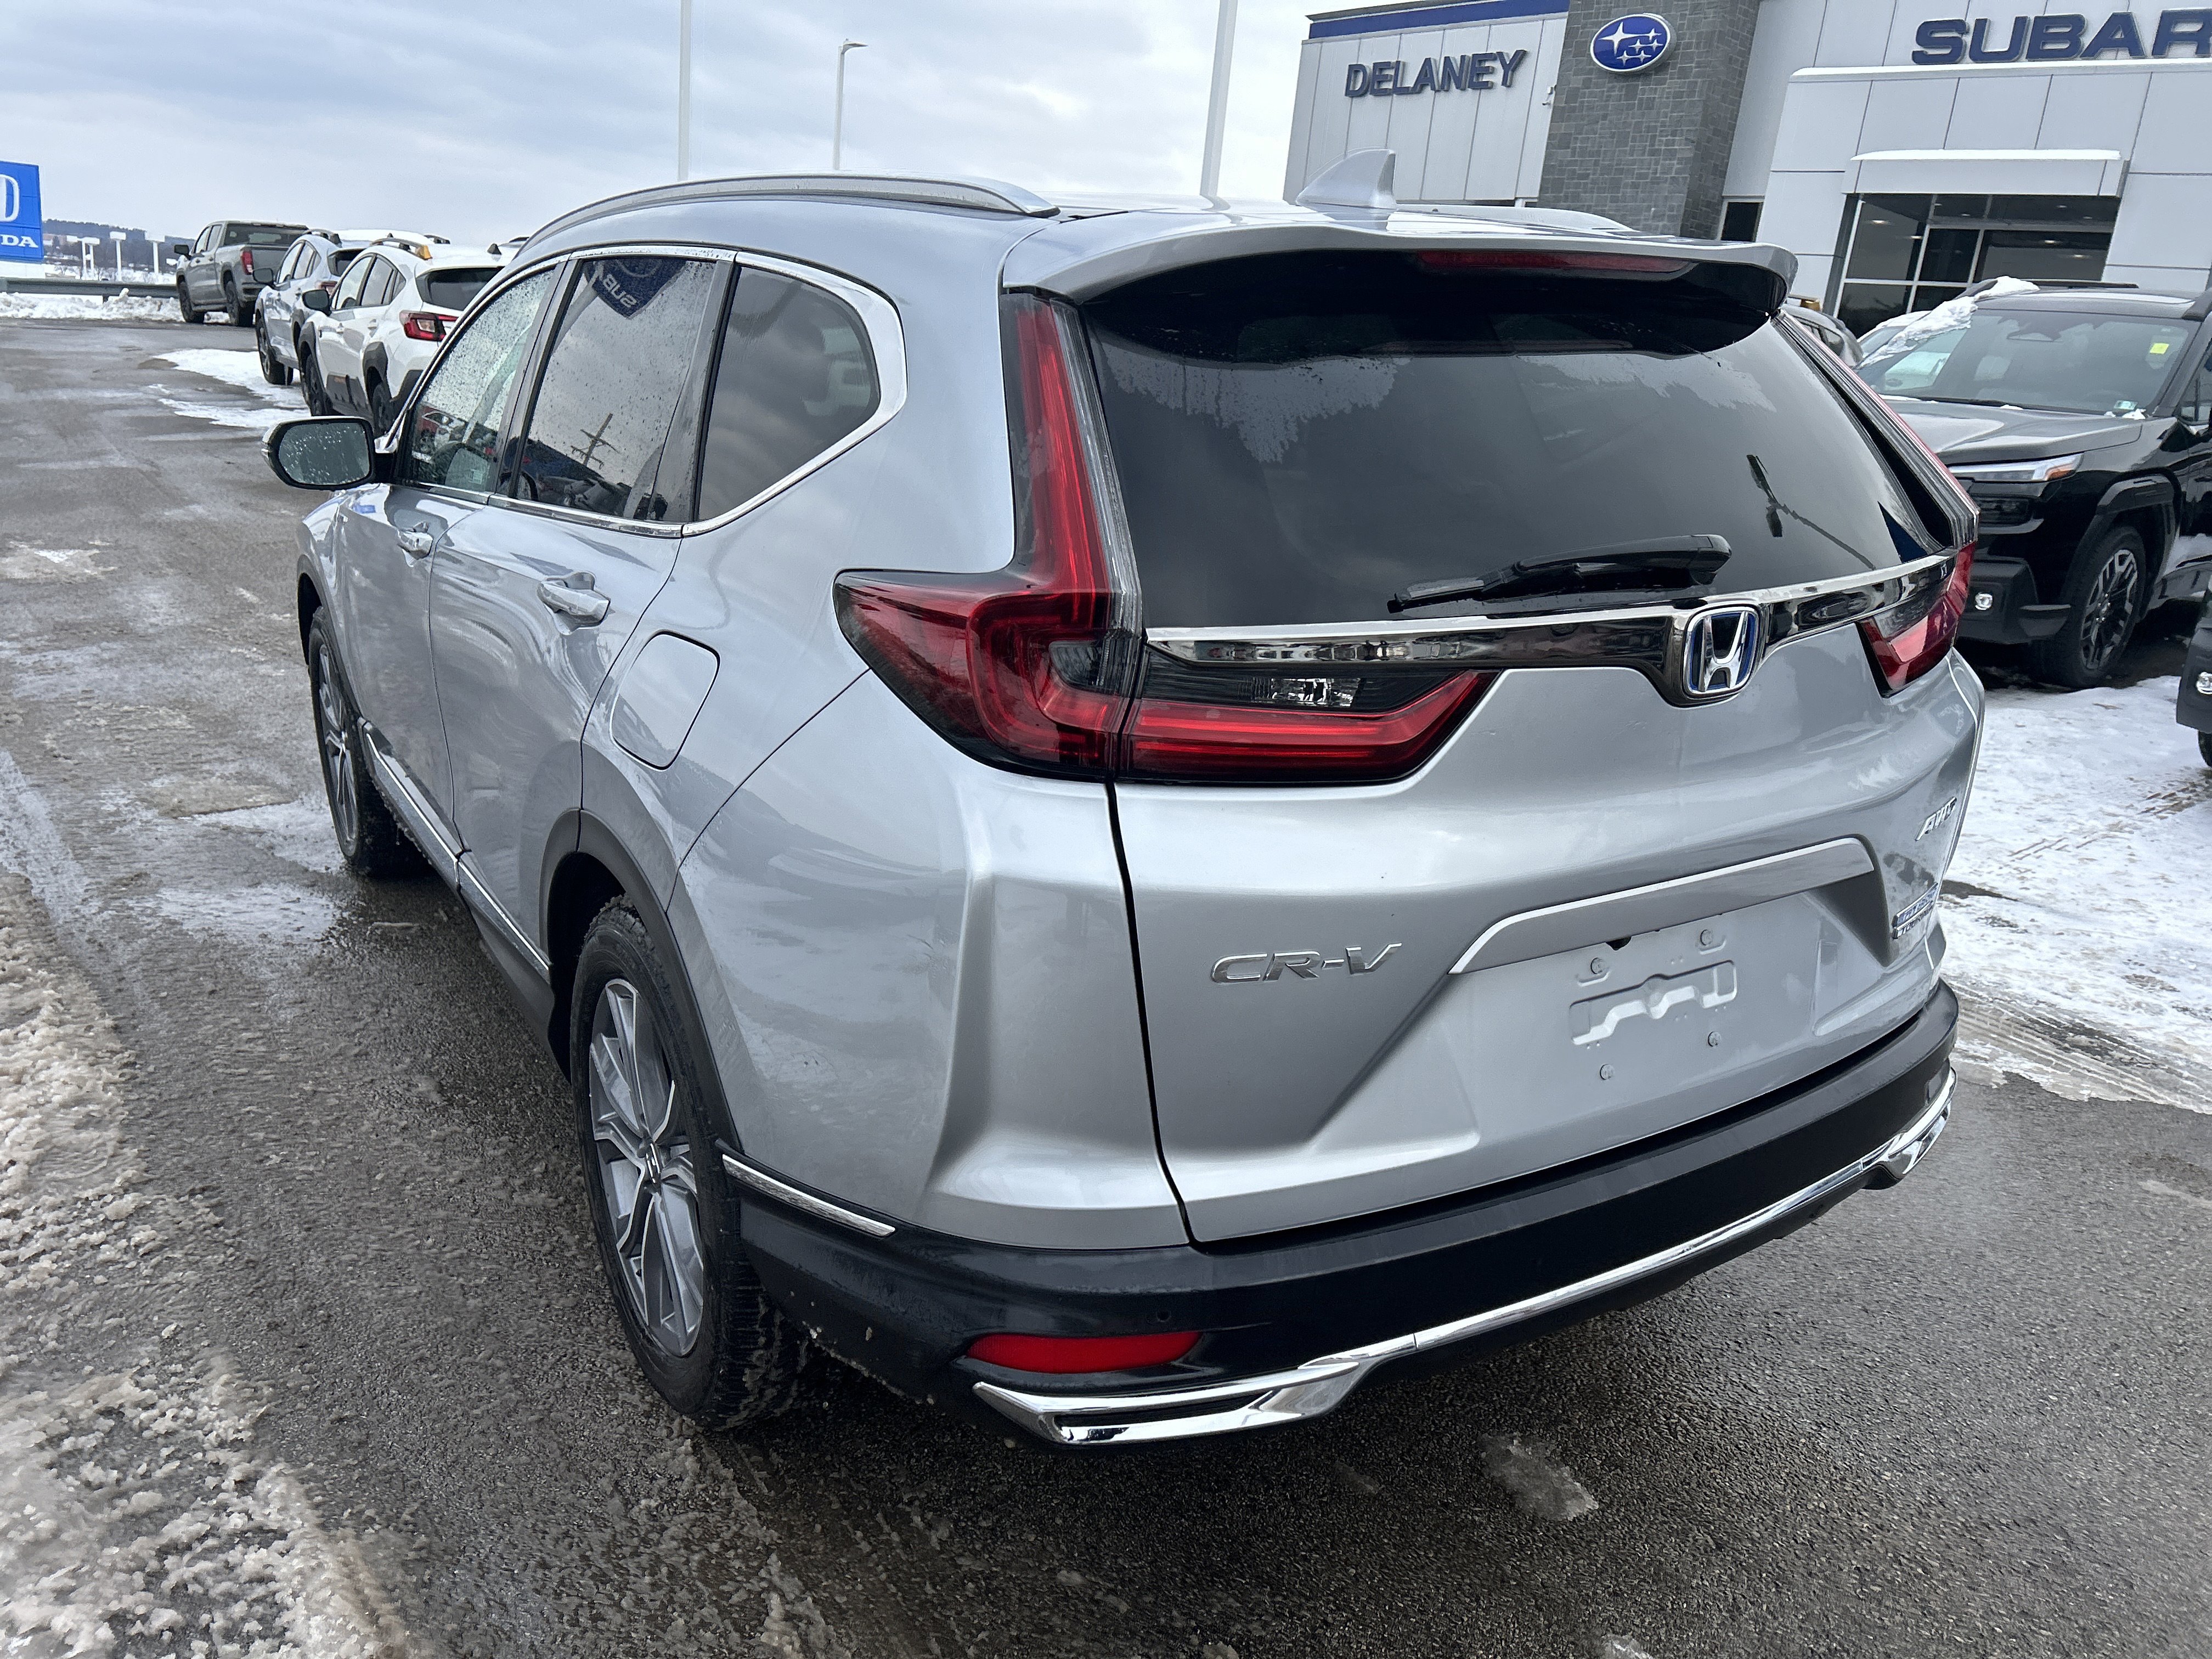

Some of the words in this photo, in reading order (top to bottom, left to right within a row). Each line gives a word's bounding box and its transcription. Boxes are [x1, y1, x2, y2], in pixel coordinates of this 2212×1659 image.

[1912, 8, 2212, 65] SUBAR
[1345, 49, 1527, 97] DELANEY
[1210, 942, 1402, 984] CR-V
